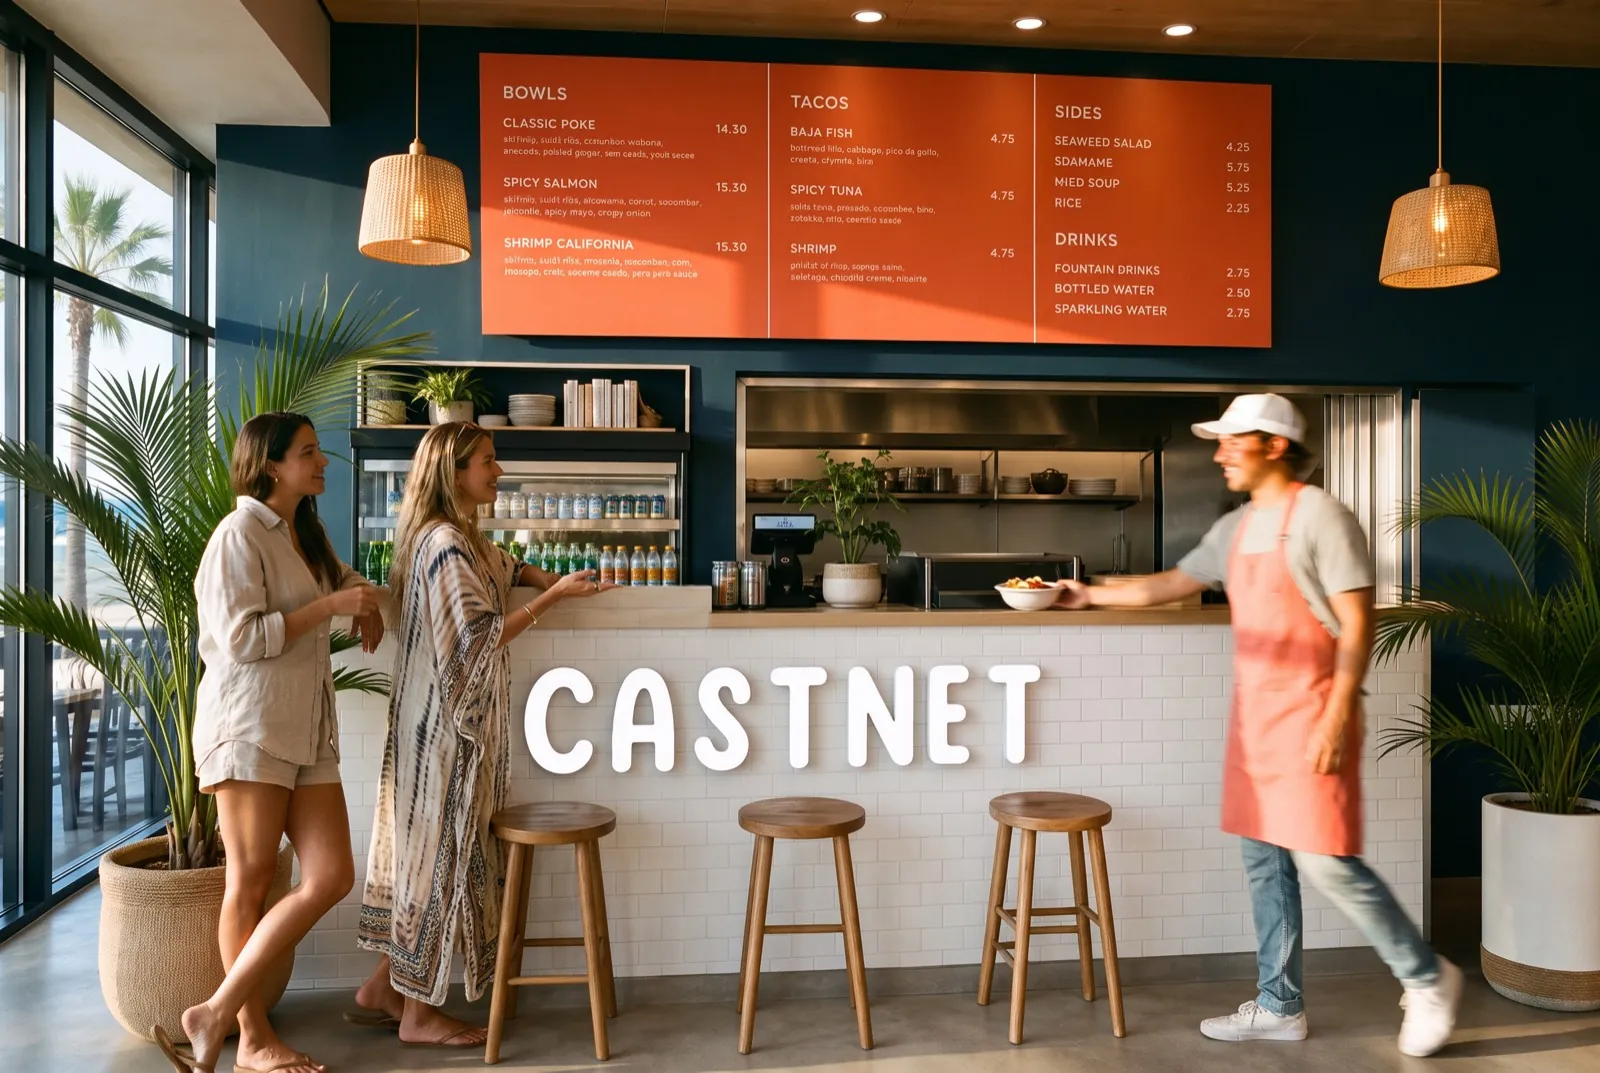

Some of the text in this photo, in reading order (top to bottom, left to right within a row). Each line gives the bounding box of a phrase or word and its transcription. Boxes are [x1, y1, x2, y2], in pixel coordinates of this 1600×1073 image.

[503, 86, 567, 100] BOWLS
[791, 95, 849, 110] TACOS
[1055, 105, 1102, 120] SIDES
[503, 118, 595, 130] CLASSIC POKE
[716, 124, 747, 134] 14.30
[790, 127, 853, 138] BAJA FISH
[991, 134, 1015, 144] 4.75
[1055, 136, 1152, 149] SEAWEED SALAD
[1226, 142, 1250, 152] 4.25
[1055, 156, 1113, 168] SDAMAME
[1227, 163, 1250, 172] 5.75
[503, 178, 597, 189] SPICY SALMON
[716, 183, 747, 193] 15.30
[1088, 178, 1120, 189] SOUP
[1227, 183, 1250, 193] 5.25
[790, 185, 863, 196] SPICY TUNA
[991, 191, 1015, 200] 4.75
[1055, 198, 1082, 208] RICE
[1226, 203, 1250, 213] 2.25
[504, 238, 634, 250] SHRIMP CALIFORNIA
[1055, 232, 1118, 247] DRINKS
[716, 242, 747, 252] 15.30
[790, 243, 837, 253] SHRIMP
[990, 248, 1015, 258] 4.75
[1055, 264, 1160, 275] FOUNTAIN DRINKS
[1226, 268, 1250, 278] 2.75
[1055, 284, 1155, 295] BOTTLED WATER
[1226, 288, 1250, 298] 2.50
[1055, 304, 1167, 316] SPARKLING WATER
[1226, 308, 1250, 318] 2.75
[524, 665, 1041, 775] CASTNET
